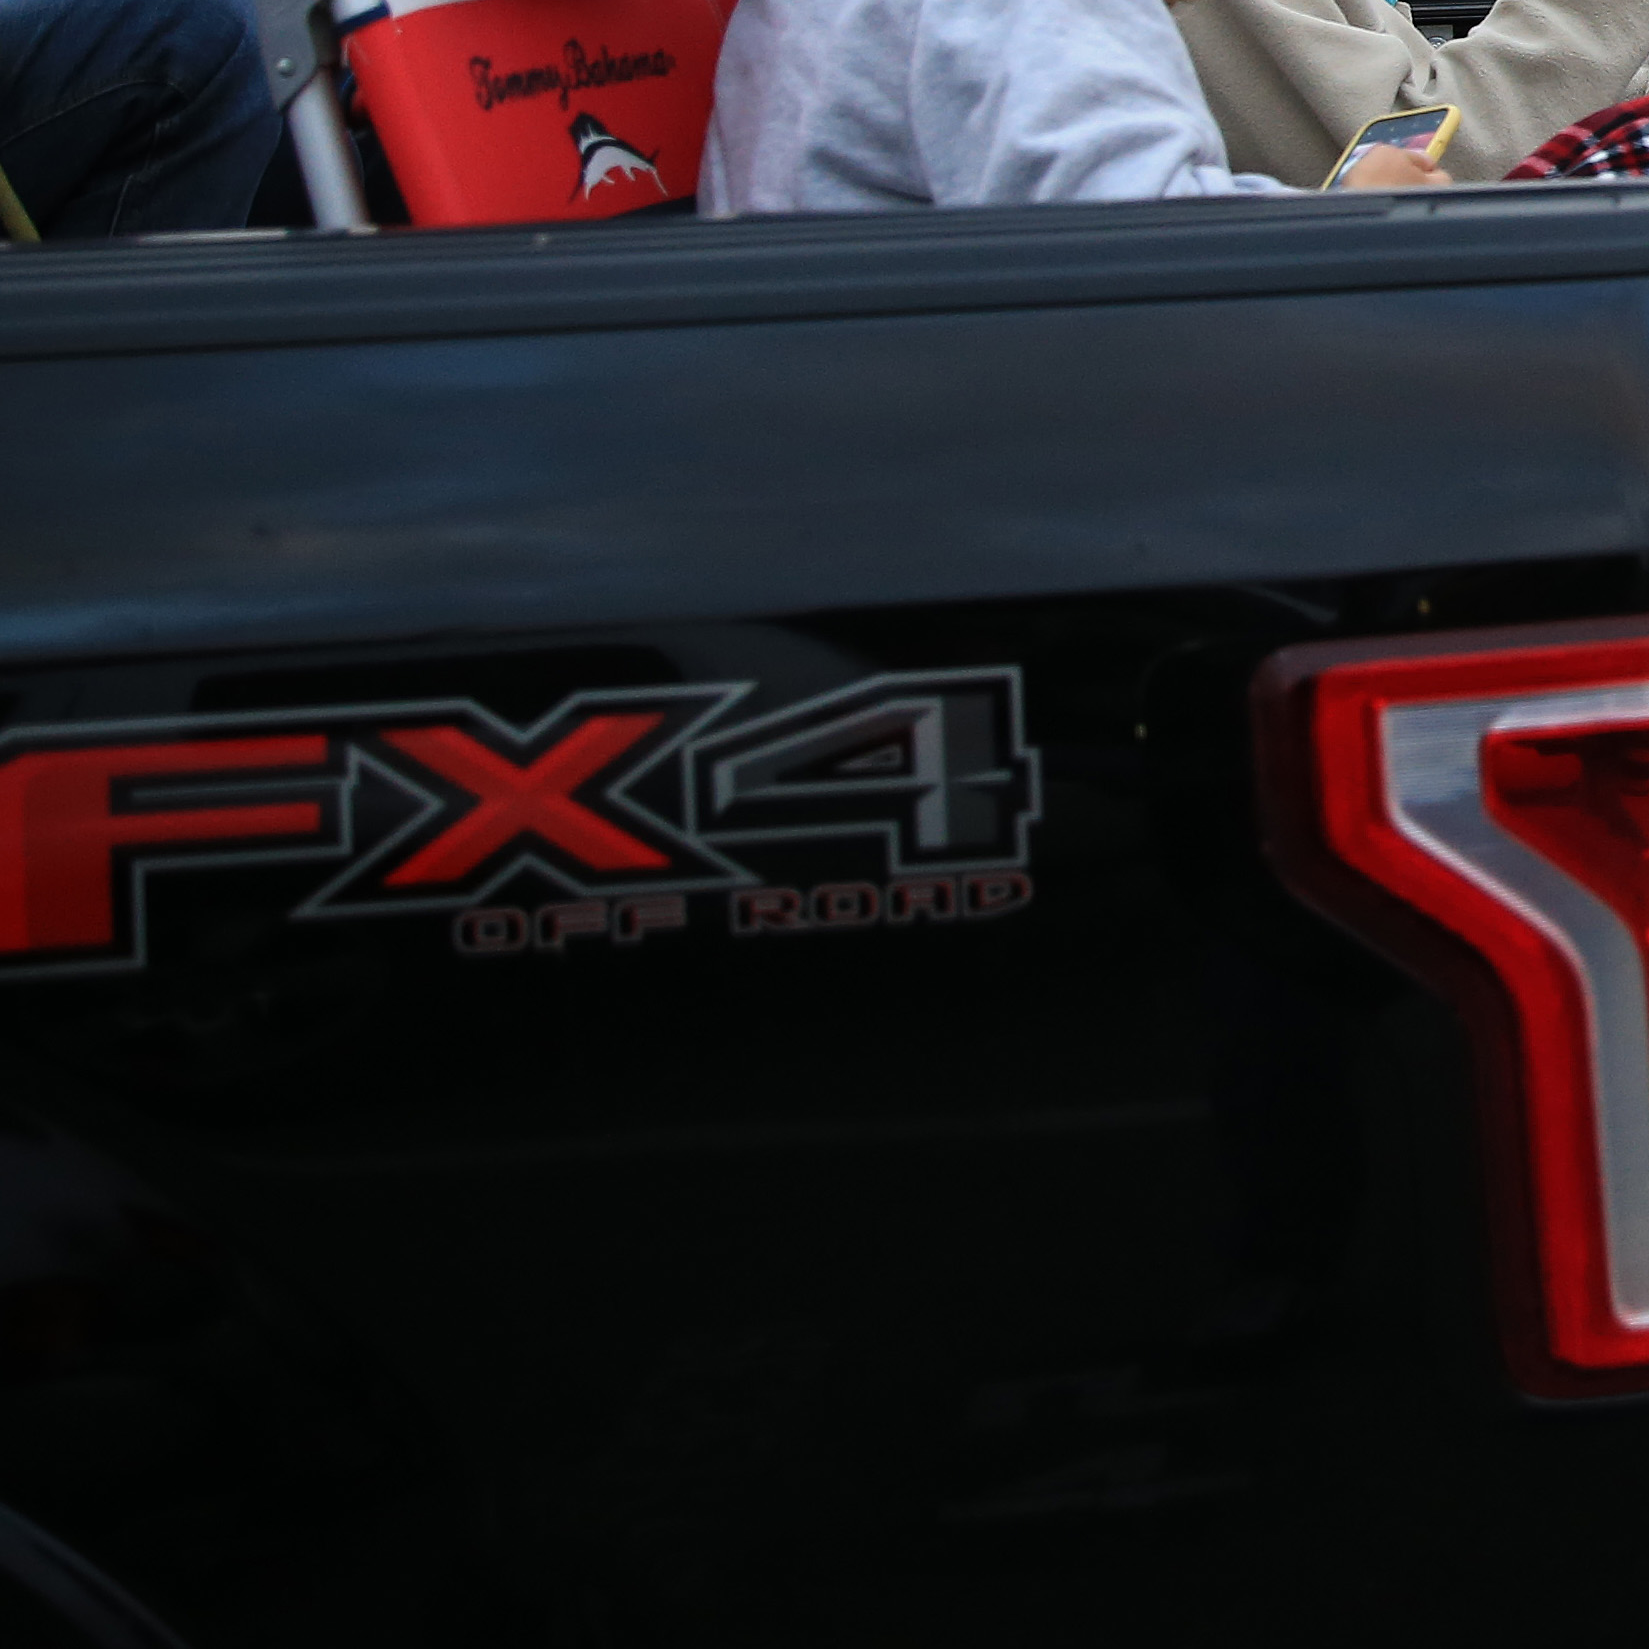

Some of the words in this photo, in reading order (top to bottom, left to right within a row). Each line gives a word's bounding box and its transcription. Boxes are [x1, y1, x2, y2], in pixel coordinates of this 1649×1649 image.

[0, 666, 1041, 977] FX4
[453, 896, 687, 952] OFF
[730, 872, 1031, 932] ROAD
